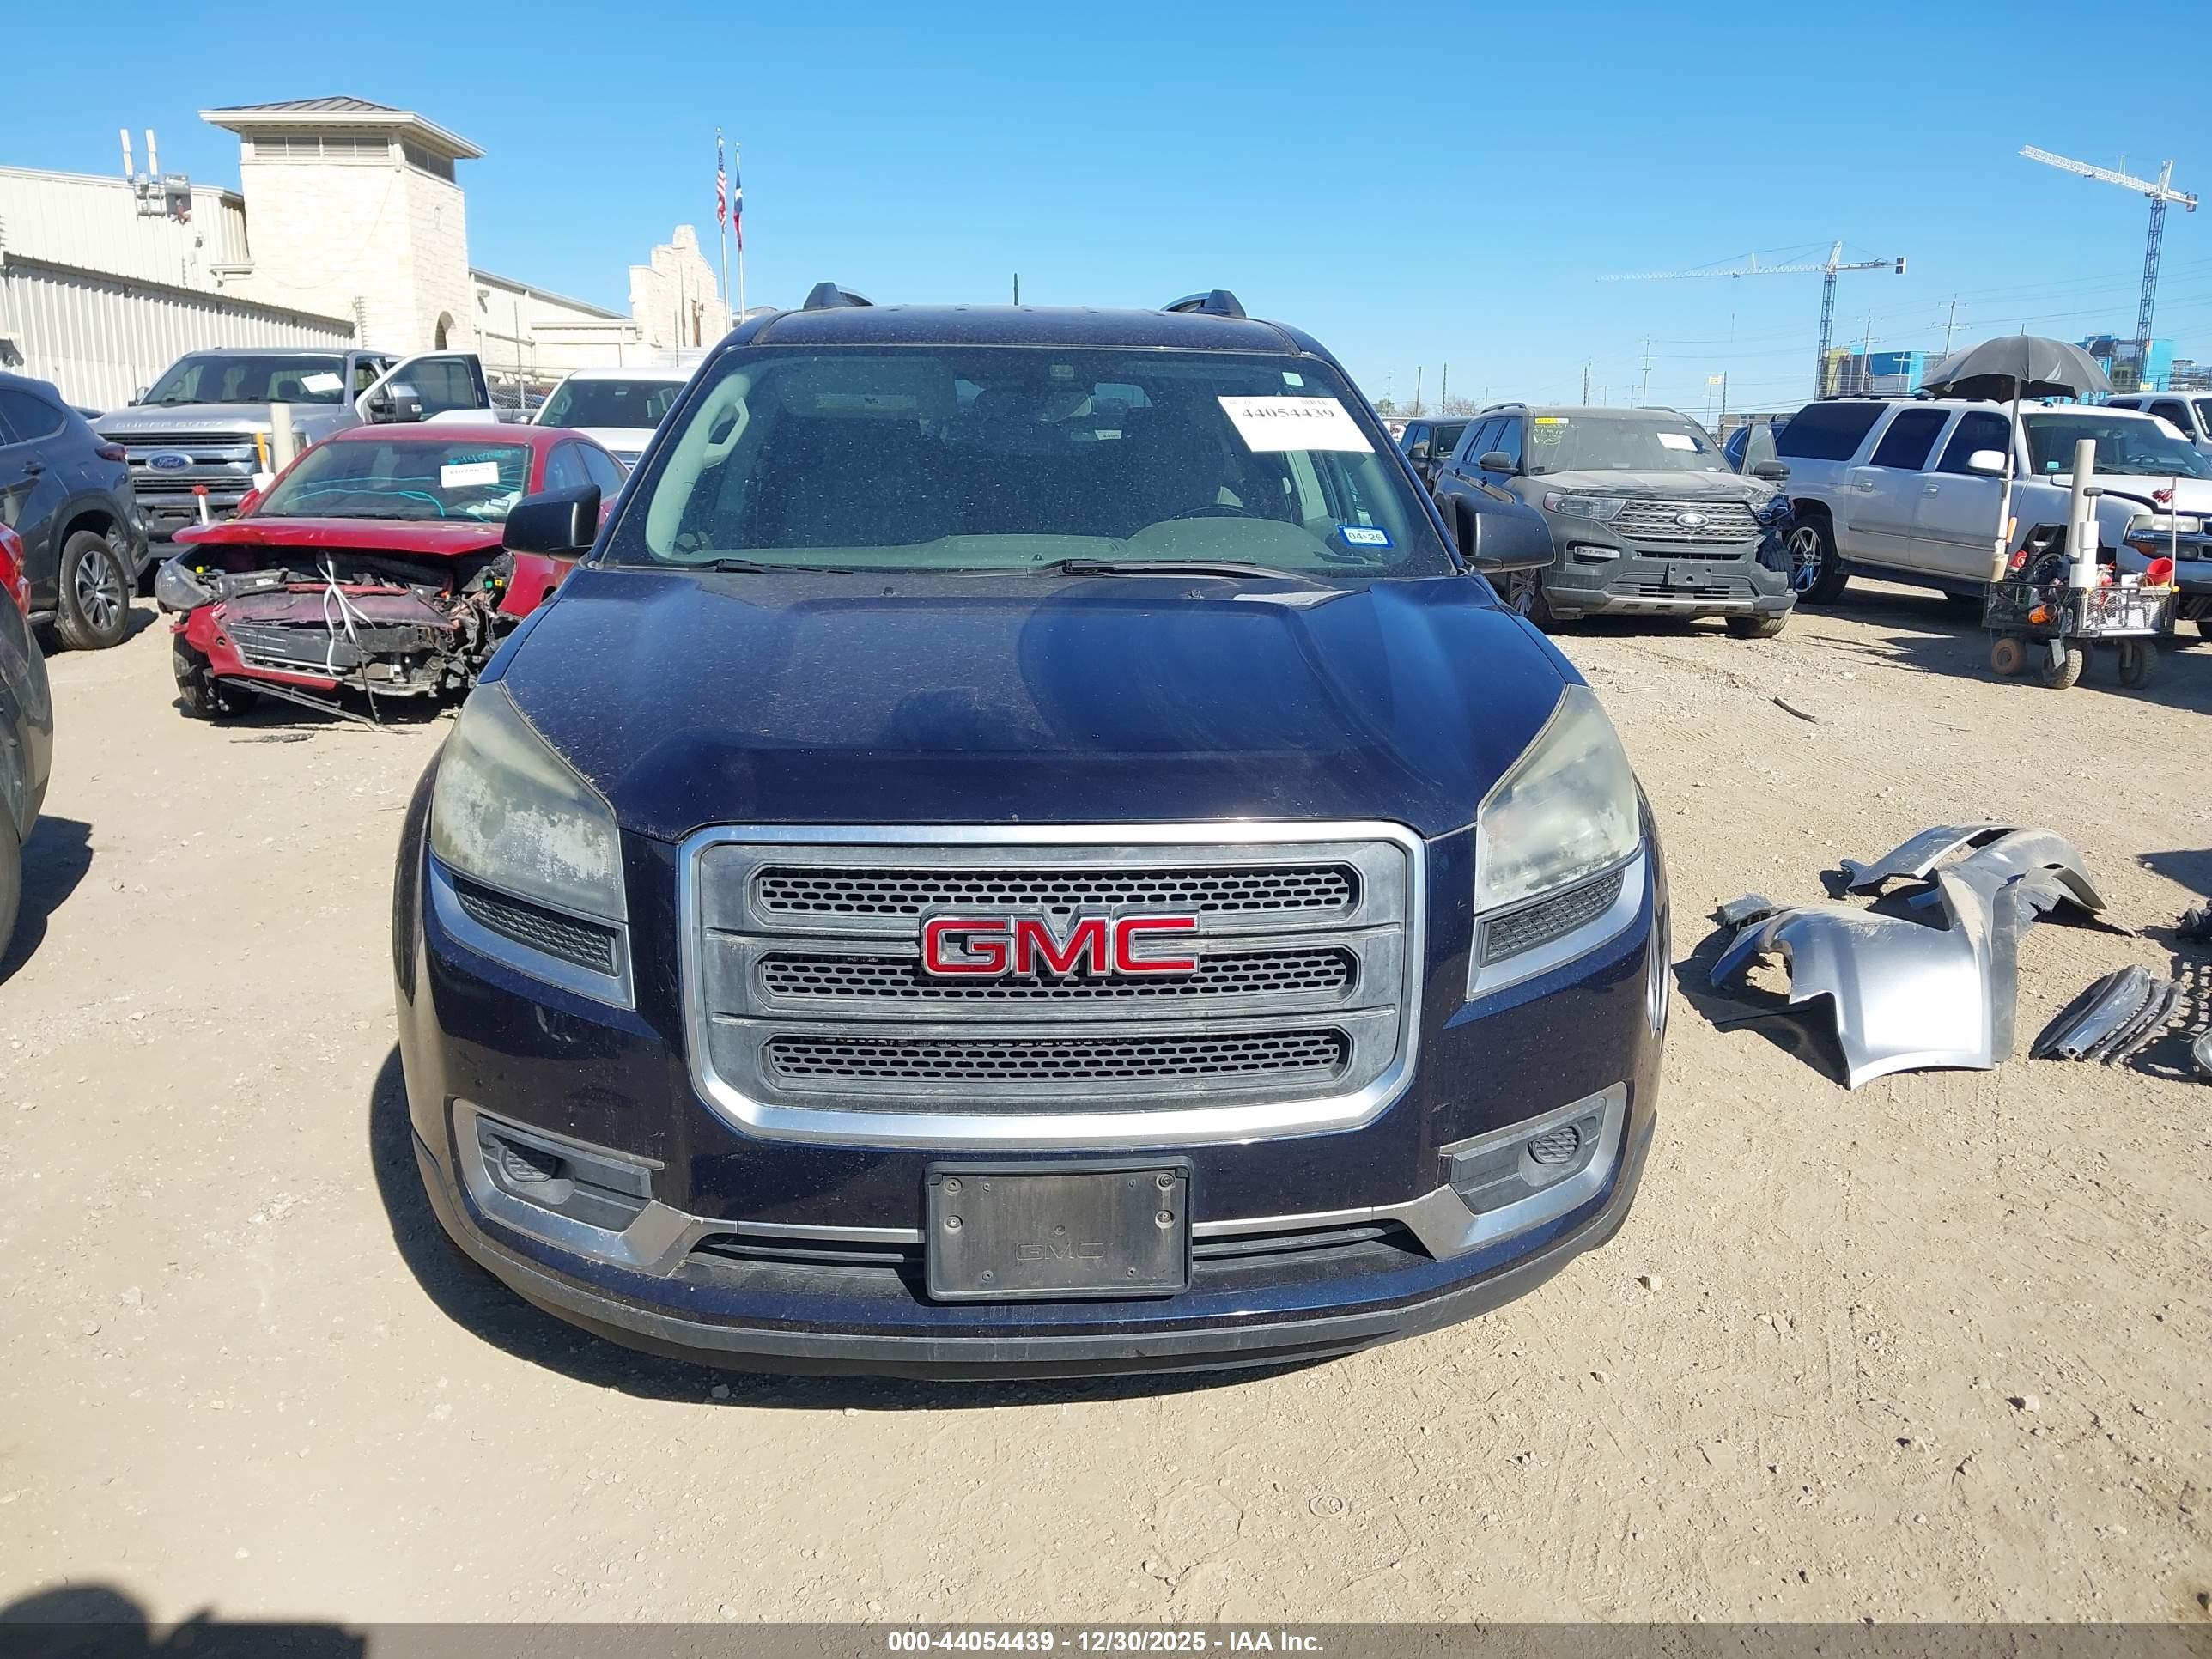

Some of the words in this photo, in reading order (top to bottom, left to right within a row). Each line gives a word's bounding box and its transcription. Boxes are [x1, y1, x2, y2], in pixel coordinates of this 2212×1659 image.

[1243, 408, 1334, 418] 44054439
[922, 910, 1200, 977] GMC
[1015, 1243, 1106, 1261] GMC
